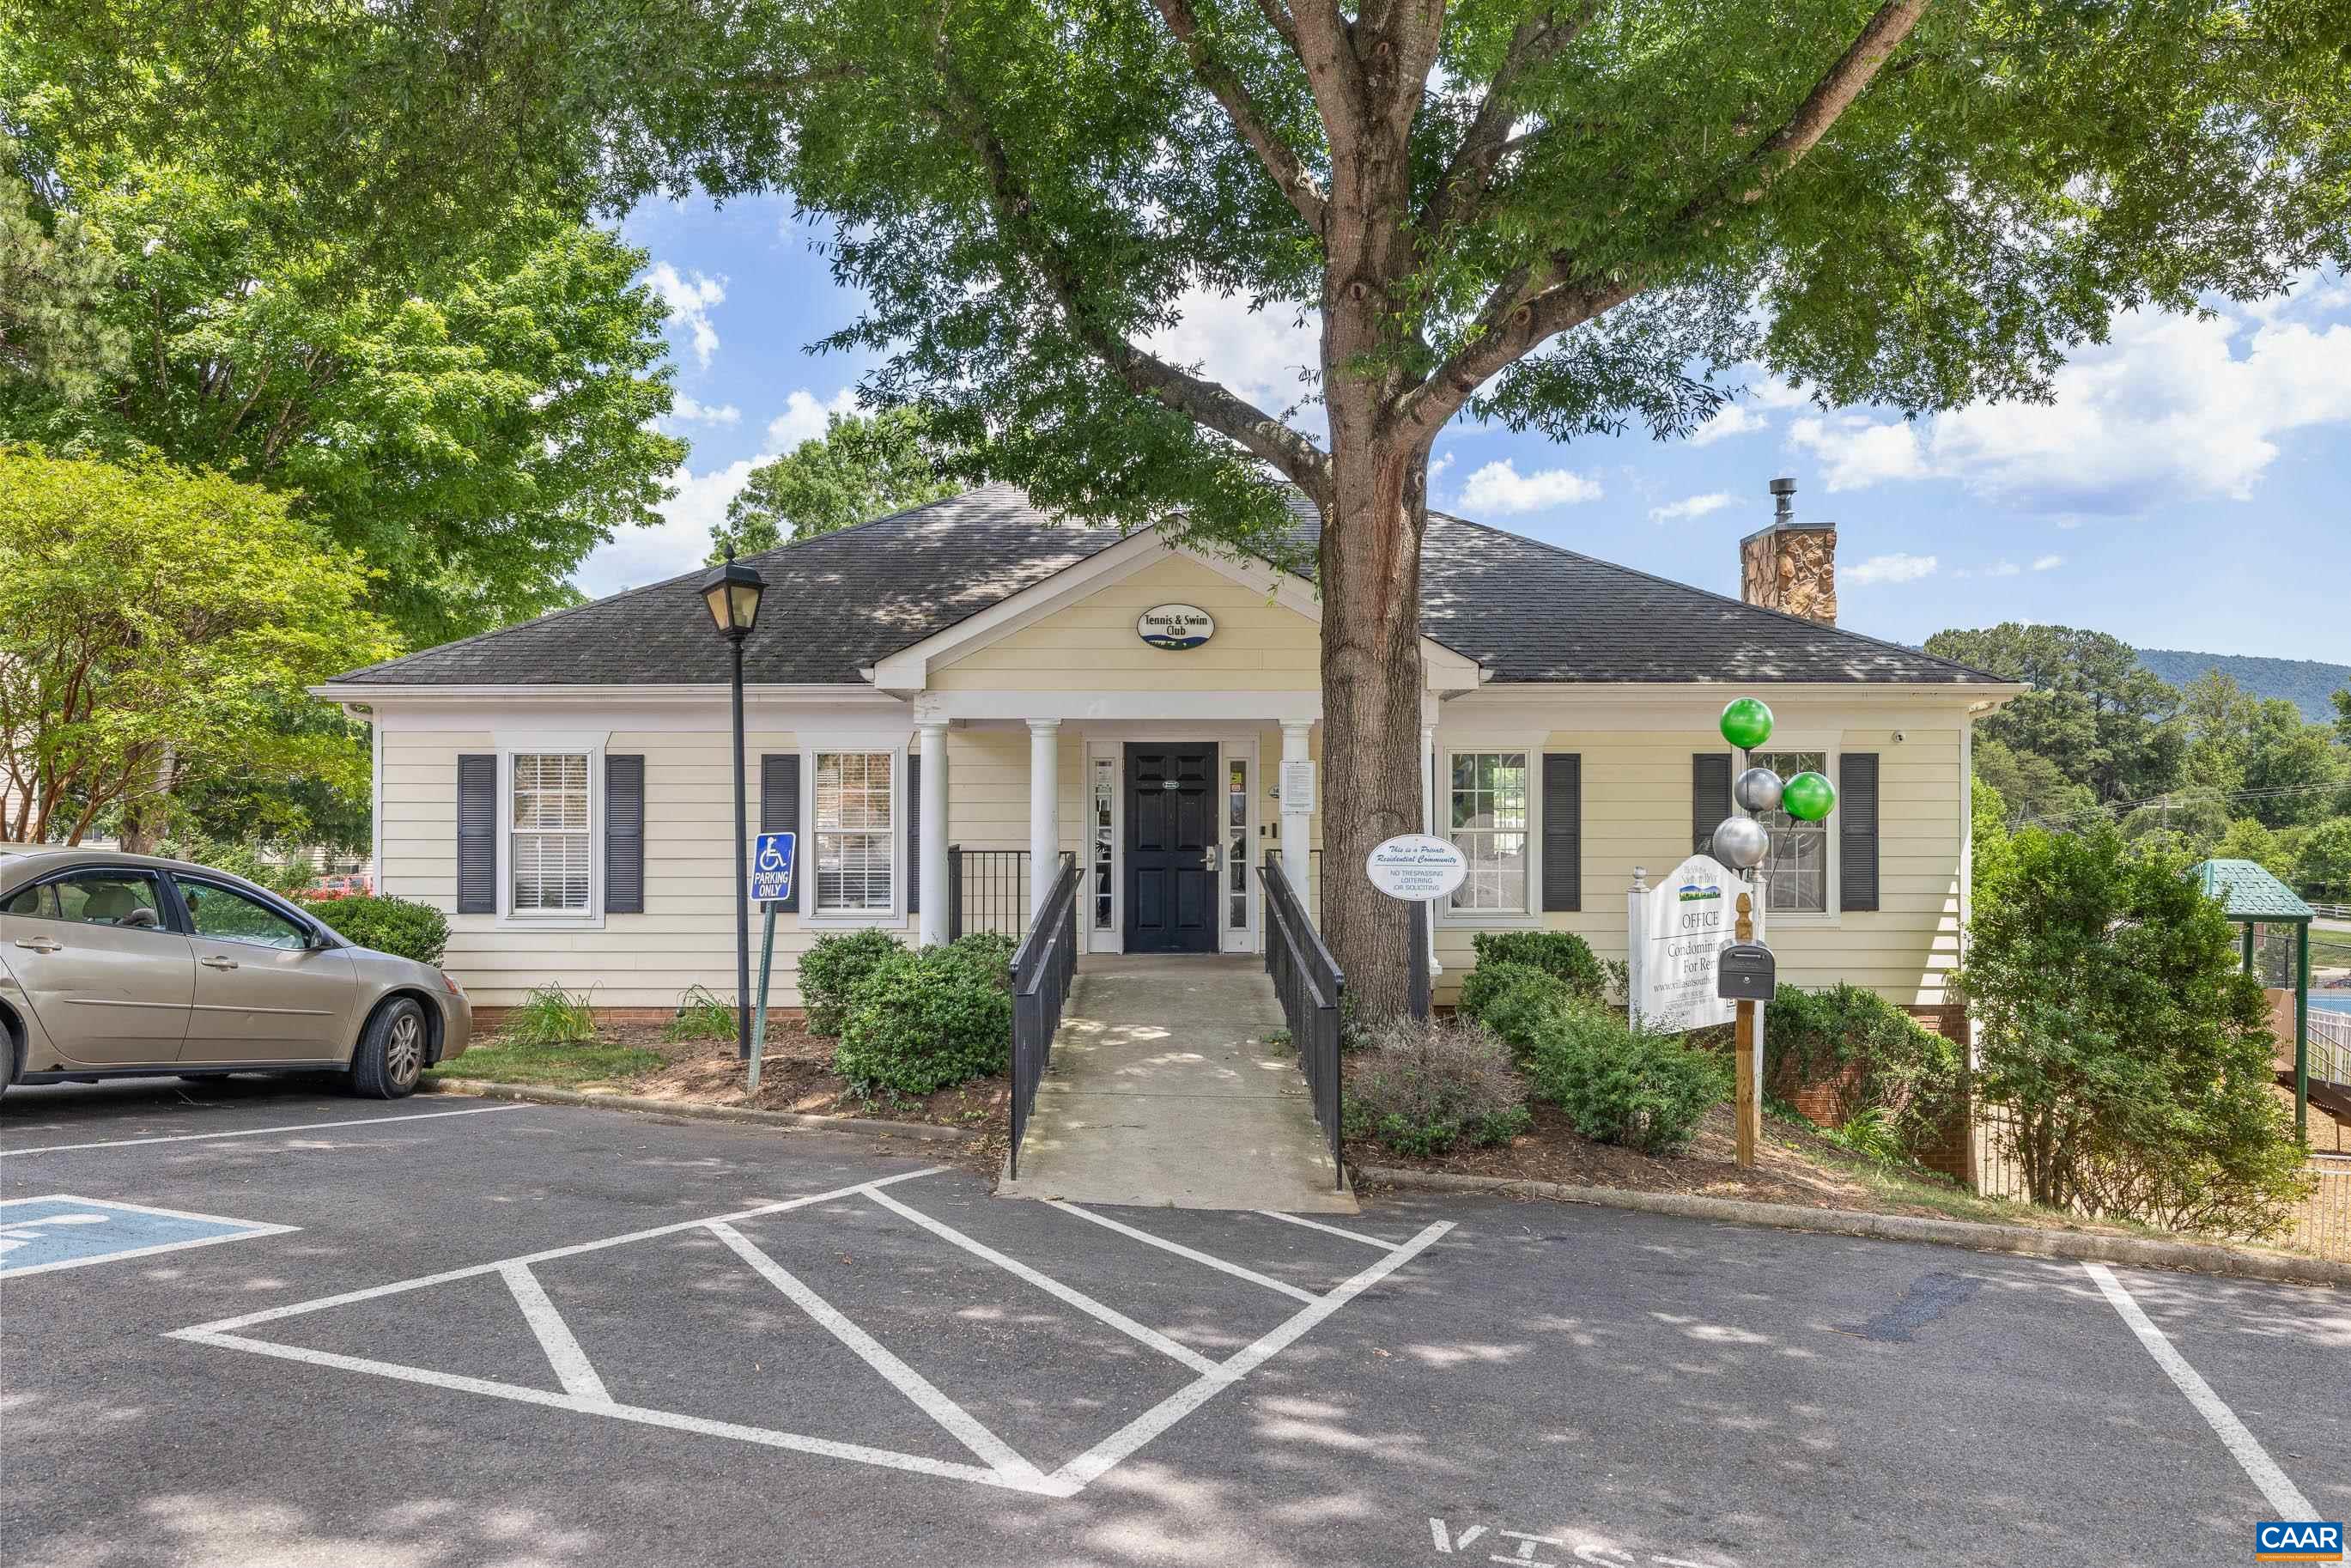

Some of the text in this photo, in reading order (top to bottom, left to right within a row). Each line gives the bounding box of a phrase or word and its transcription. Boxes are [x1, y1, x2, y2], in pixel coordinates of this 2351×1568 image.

[1145, 615, 1207, 625] Tennis & Swim
[1166, 625, 1186, 635] Club
[1417, 855, 1457, 864] Community
[755, 872, 788, 884] PARKING
[759, 884, 781, 896] ONLY
[1682, 911, 1719, 928] OFFICE
[1668, 938, 1718, 957] Condomini
[1684, 956, 1718, 973] For Ren
